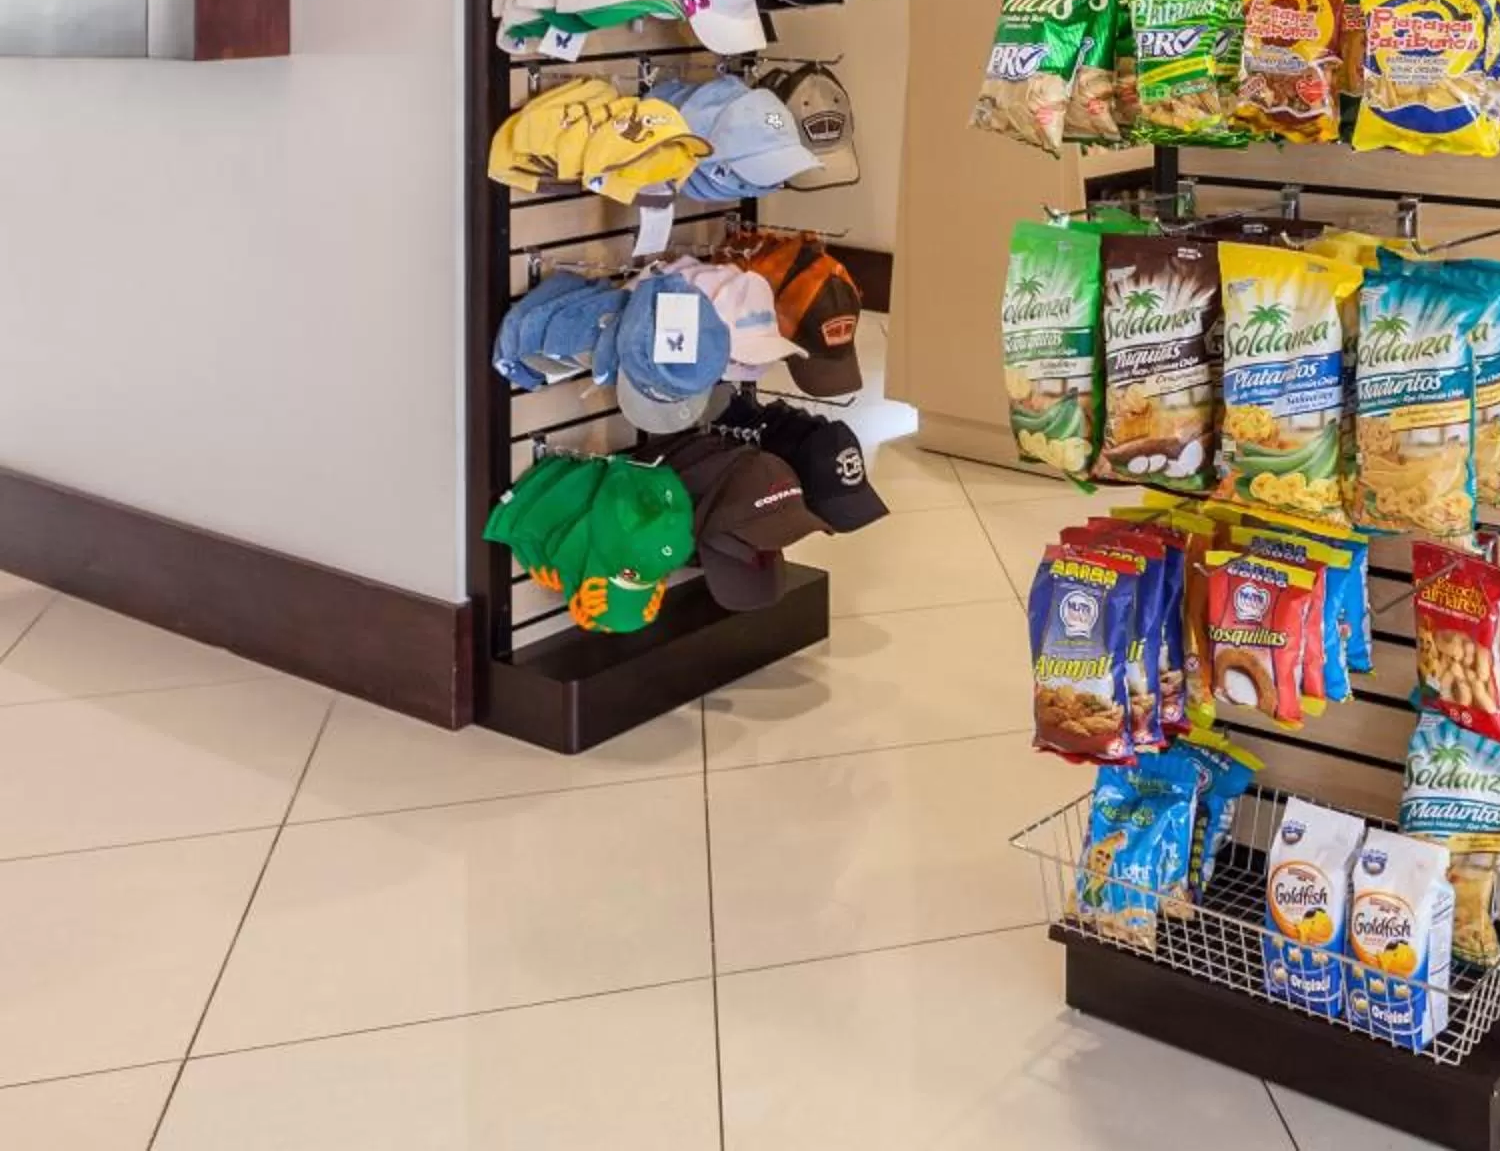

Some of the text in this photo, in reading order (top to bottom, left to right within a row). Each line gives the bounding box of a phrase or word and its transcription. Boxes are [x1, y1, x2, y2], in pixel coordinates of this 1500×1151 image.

[1003, 296, 1072, 325] oldanza
[1104, 307, 1200, 342] Soldanza
[1224, 318, 1329, 362] Soldanza
[1358, 332, 1453, 367] oldanza
[1275, 882, 1328, 906] Goldfish
[1353, 912, 1411, 938] Goldfish
